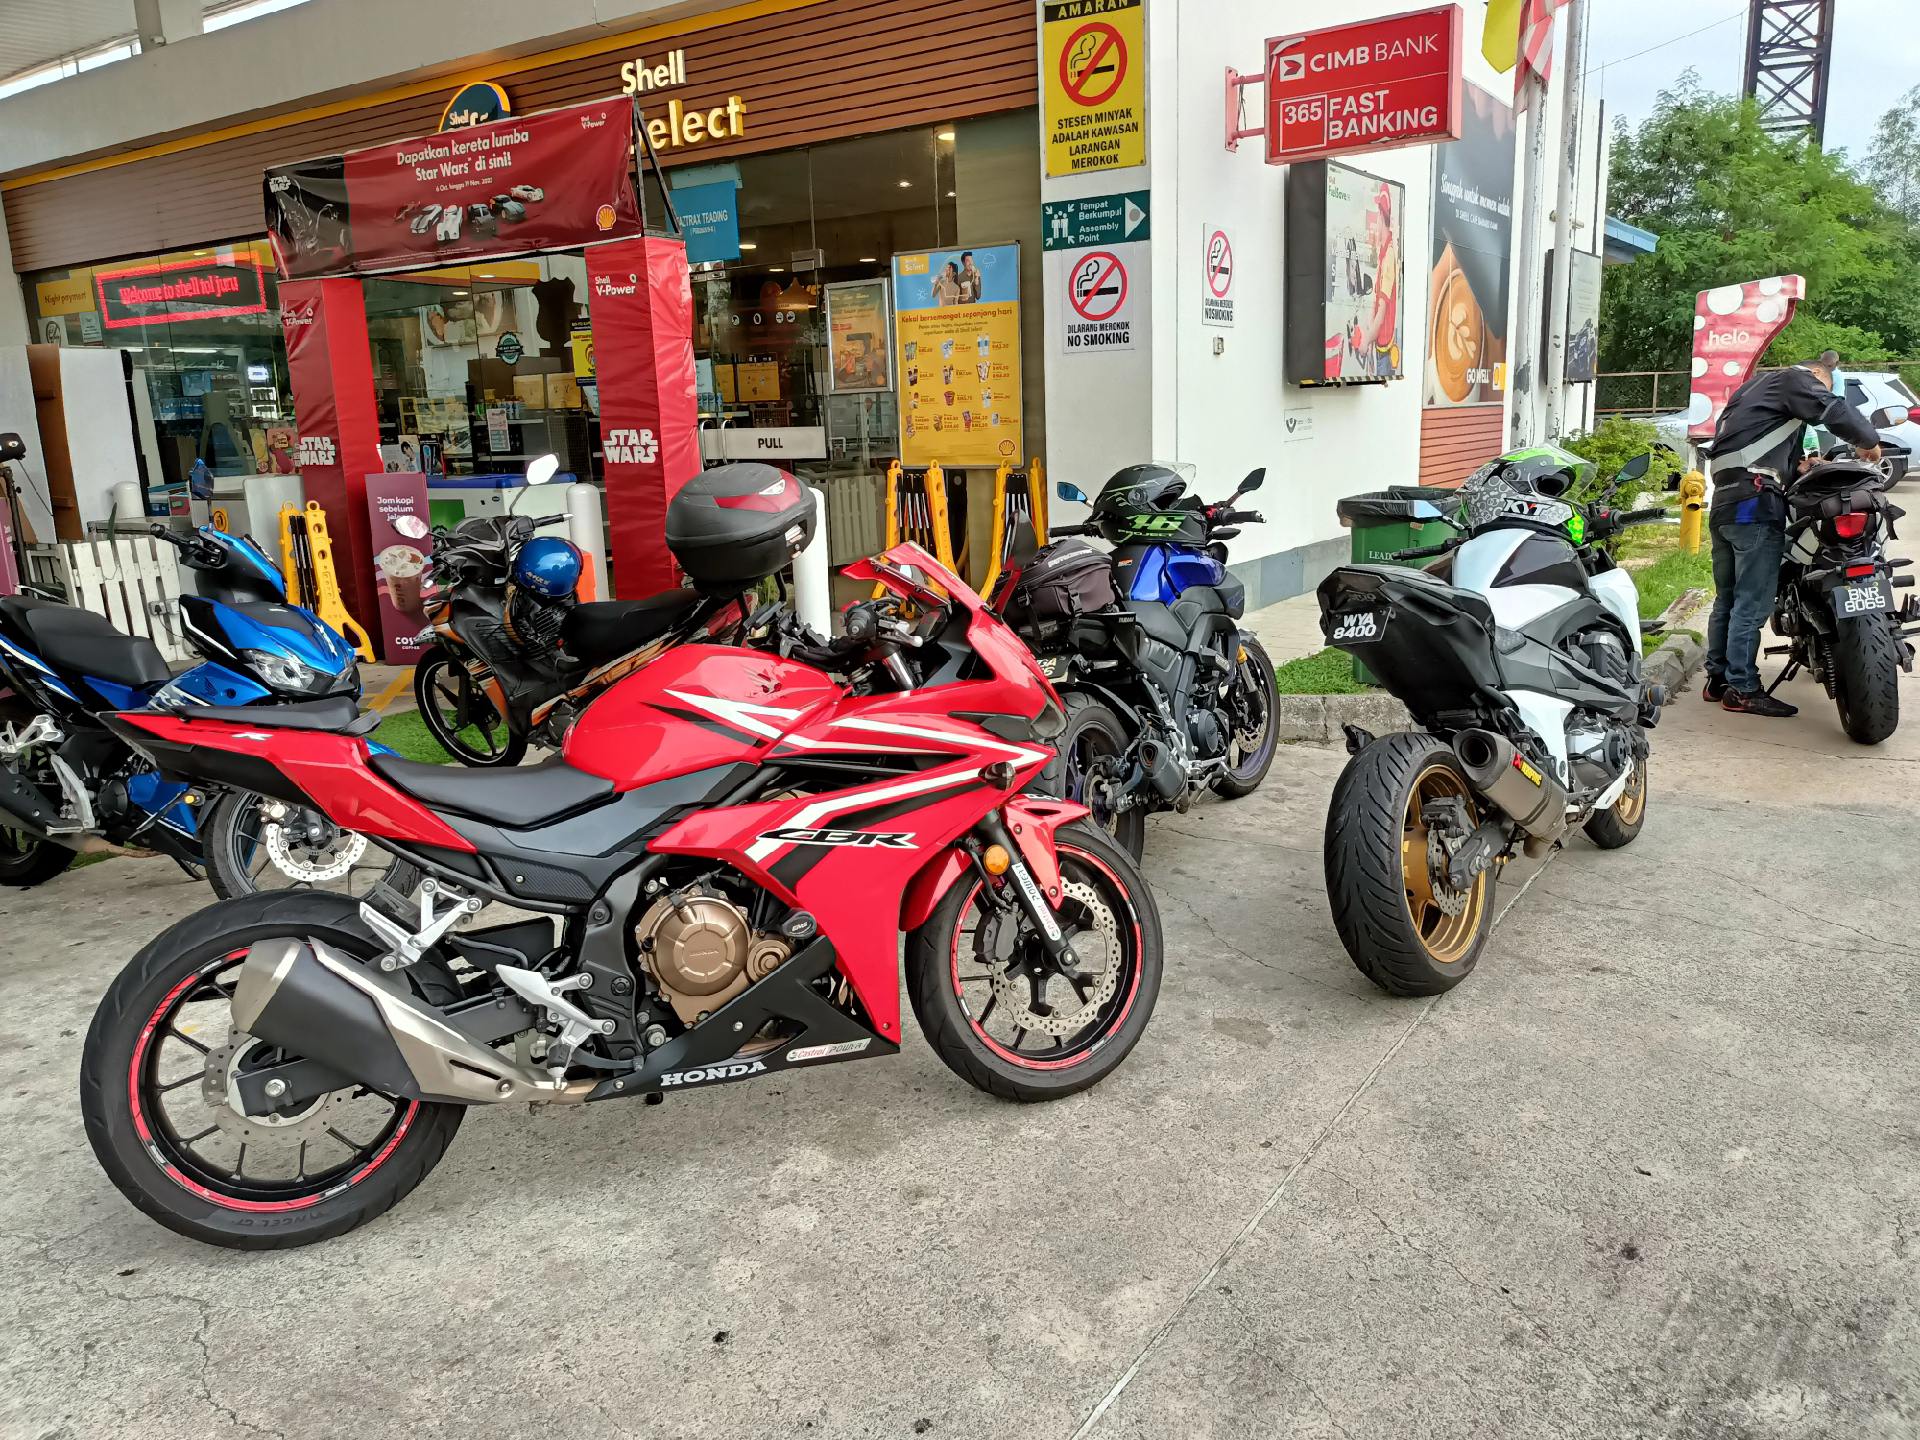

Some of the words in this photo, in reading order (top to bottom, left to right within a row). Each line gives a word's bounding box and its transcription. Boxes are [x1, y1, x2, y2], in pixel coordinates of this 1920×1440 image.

[1058, 0, 1128, 19] AMARAN
[1309, 46, 1370, 73] CIMB
[1375, 33, 1439, 62] BANK
[621, 49, 687, 94] Shell
[1284, 101, 1322, 126] 365
[1328, 89, 1390, 119] FAST
[449, 109, 469, 126] Shell
[1057, 114, 1094, 130] STESEN
[1094, 107, 1133, 124] MINYAK
[1328, 105, 1438, 141] BANKING
[1052, 129, 1090, 145] ADALAH
[1091, 122, 1139, 139] KAWASAN
[396, 145, 450, 167] Dapatkan
[452, 137, 489, 157] kereta
[492, 129, 530, 148] lumba
[1069, 139, 1121, 157] LARANGAN
[415, 166, 439, 182] Star
[475, 155, 487, 172] di
[489, 152, 512, 169] sini!
[1071, 154, 1120, 170] MEROKOK
[1078, 208, 1122, 221] Berkumpul
[1079, 200, 1108, 212] Tempat
[1079, 222, 1119, 234] Assembly
[1078, 233, 1100, 244] Point
[175, 276, 201, 298] shell
[594, 275, 611, 285] Shell
[595, 284, 636, 297] V-Power
[1067, 324, 1098, 335] DILARANG
[1099, 321, 1130, 333] MEROKOK
[1067, 335, 1082, 348] NO
[1083, 331, 1130, 347] SMOKING
[1466, 368, 1476, 384] GO
[1476, 368, 1489, 384] WELL
[301, 436, 335, 451] STAR
[603, 429, 658, 446] STAR
[758, 438, 783, 450] PULL
[301, 450, 336, 466] WARS
[603, 446, 659, 464] WARS
[379, 505, 414, 514] sebelum
[1502, 498, 1553, 516] KYT
[1848, 586, 1880, 600] BNR
[1844, 595, 1886, 613] 8069
[1343, 612, 1374, 628] WYA
[1333, 623, 1377, 640] 8400
[755, 828, 920, 849] CBR
[798, 1047, 827, 1059] Castrol
[661, 1061, 767, 1087] HONDA
